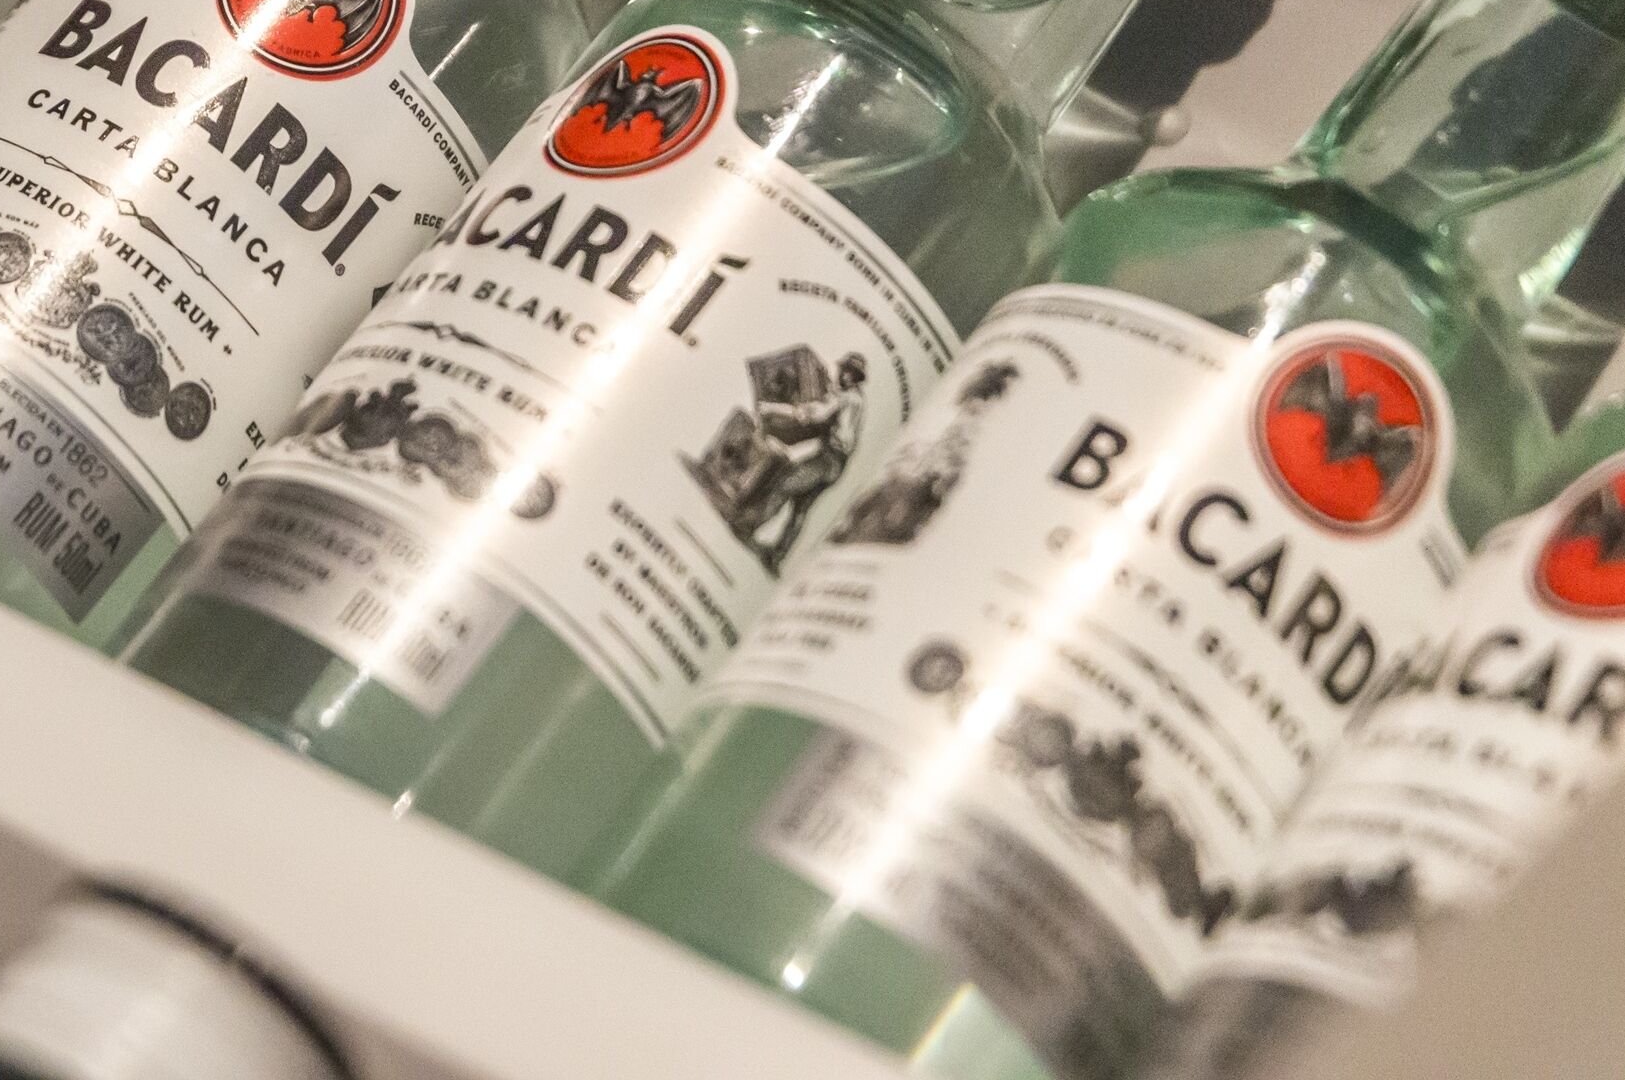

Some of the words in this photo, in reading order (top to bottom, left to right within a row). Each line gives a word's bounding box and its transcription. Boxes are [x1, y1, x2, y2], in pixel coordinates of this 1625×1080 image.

[27, 88, 141, 159] CARTA
[389, 78, 437, 133] BACARDÍ
[433, 131, 471, 189] COMPANY
[153, 156, 286, 288] BLANCA
[413, 212, 446, 231] RECE
[98, 226, 173, 294] WHITE
[173, 289, 221, 343] RUM
[59, 435, 109, 488] 1862
[13, 491, 69, 554] RUM
[51, 532, 105, 594] 50ml
[66, 486, 123, 556] CUBA
